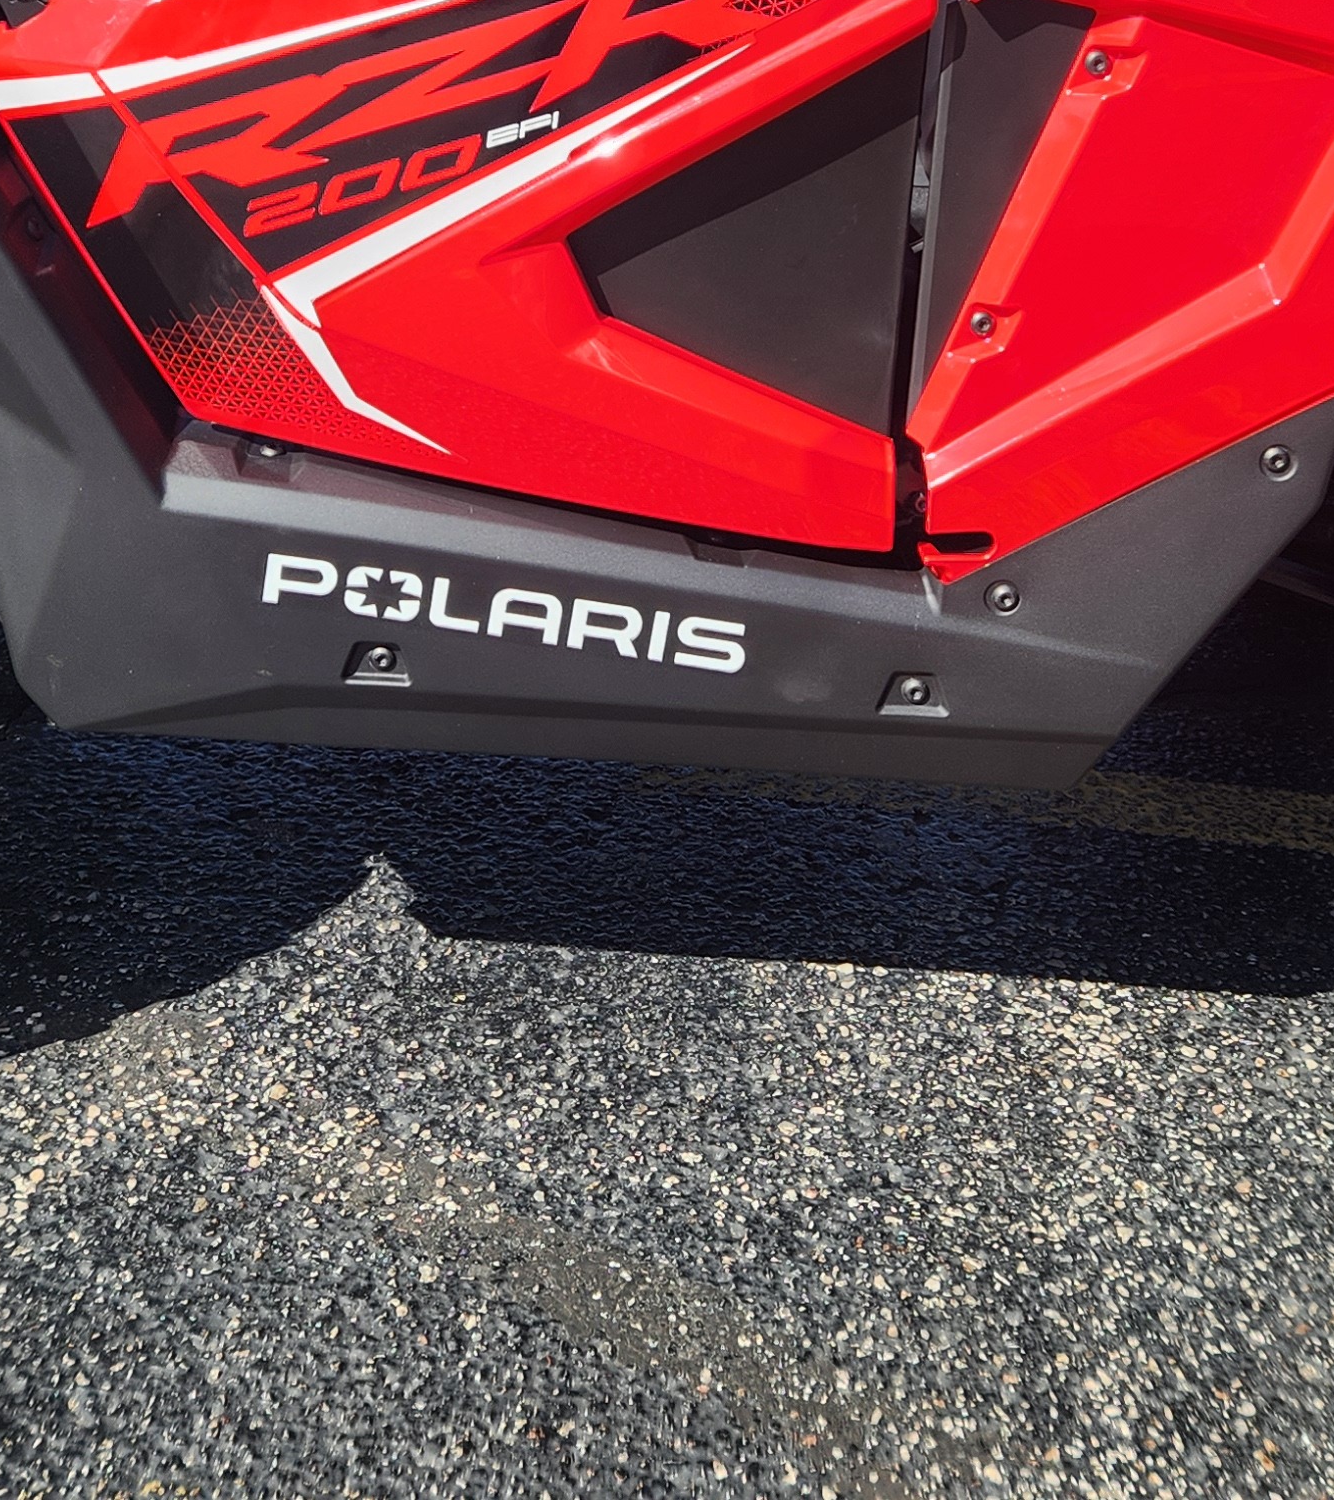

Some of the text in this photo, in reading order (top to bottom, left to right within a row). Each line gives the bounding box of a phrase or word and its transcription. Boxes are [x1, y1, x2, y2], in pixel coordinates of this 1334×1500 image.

[243, 110, 559, 238] 200 EFI
[261, 552, 746, 674] POLARIS
